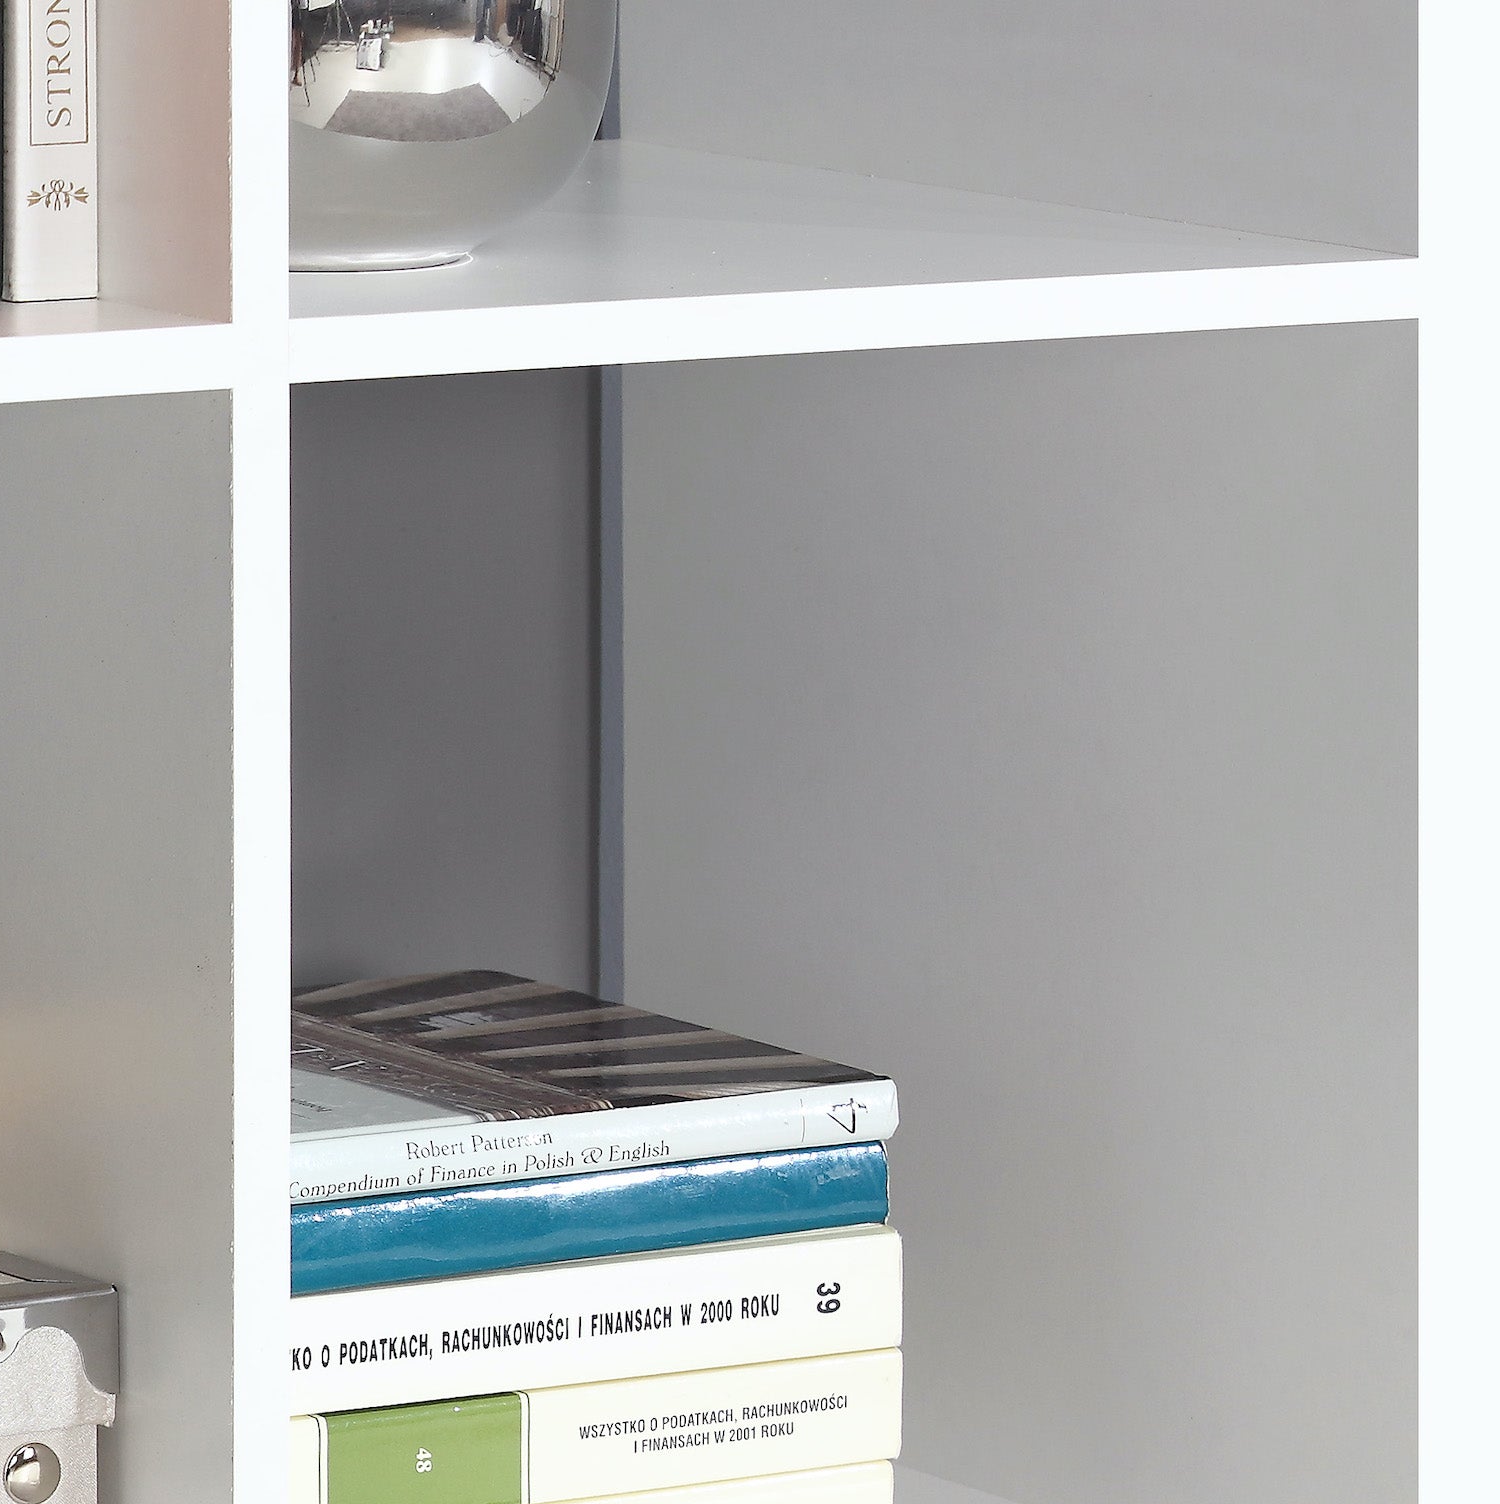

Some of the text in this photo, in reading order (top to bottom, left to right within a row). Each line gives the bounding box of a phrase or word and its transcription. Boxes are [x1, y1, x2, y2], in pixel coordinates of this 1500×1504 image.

[405, 1140, 467, 1161] Robert
[289, 1140, 671, 1200] Compendium of Finance in Polish & English
[816, 1281, 842, 1315] 39
[289, 1293, 780, 1372] KO O PODATKACH, RACHUNKOWOŚCI I FINANSACH W 2000 ROKU
[579, 1418, 647, 1440] WSZYSTKO
[649, 1417, 659, 1432] O
[742, 1392, 849, 1421] RACHUNKOWOŚCI
[642, 1431, 711, 1453] FINANSACH
[714, 1429, 726, 1445] W
[729, 1425, 757, 1443] 2001
[760, 1421, 795, 1438] ROKU
[415, 1447, 433, 1474] 48
